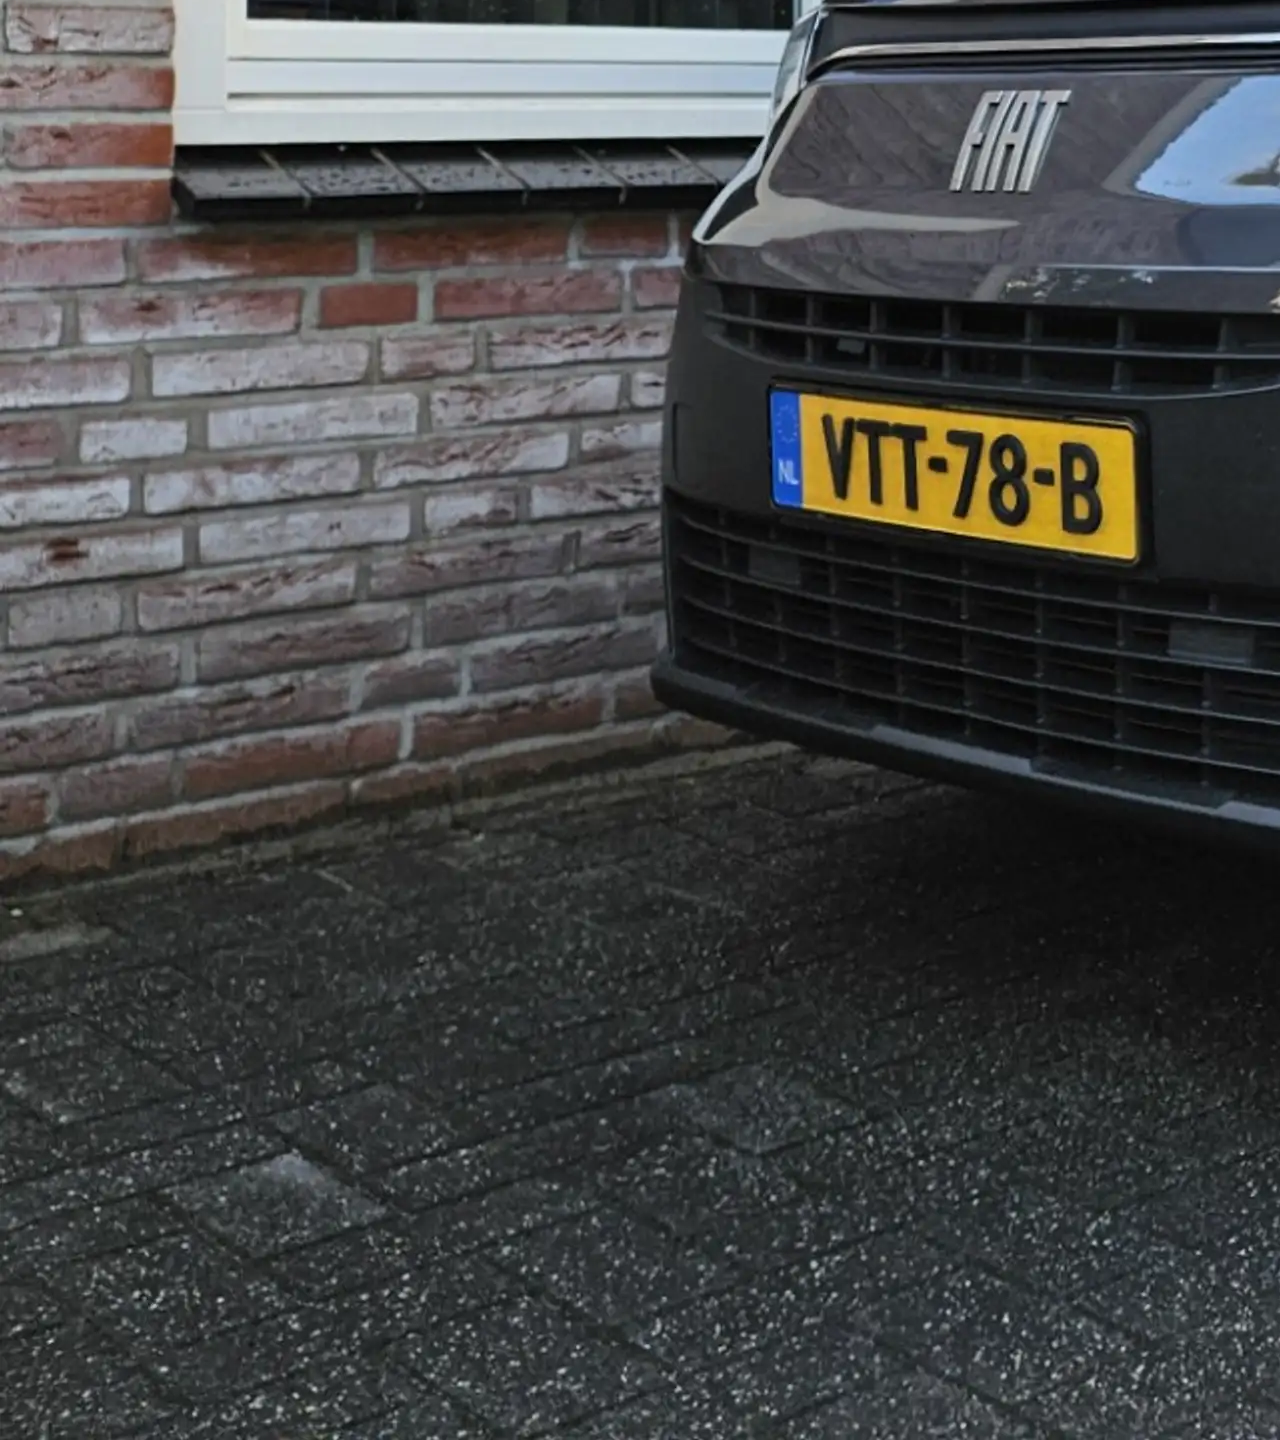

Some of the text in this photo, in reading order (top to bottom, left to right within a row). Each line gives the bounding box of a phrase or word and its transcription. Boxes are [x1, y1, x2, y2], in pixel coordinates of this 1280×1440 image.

[950, 89, 1071, 194] FIAT
[778, 458, 798, 485] NL
[822, 413, 1102, 535] VTT-78-B
